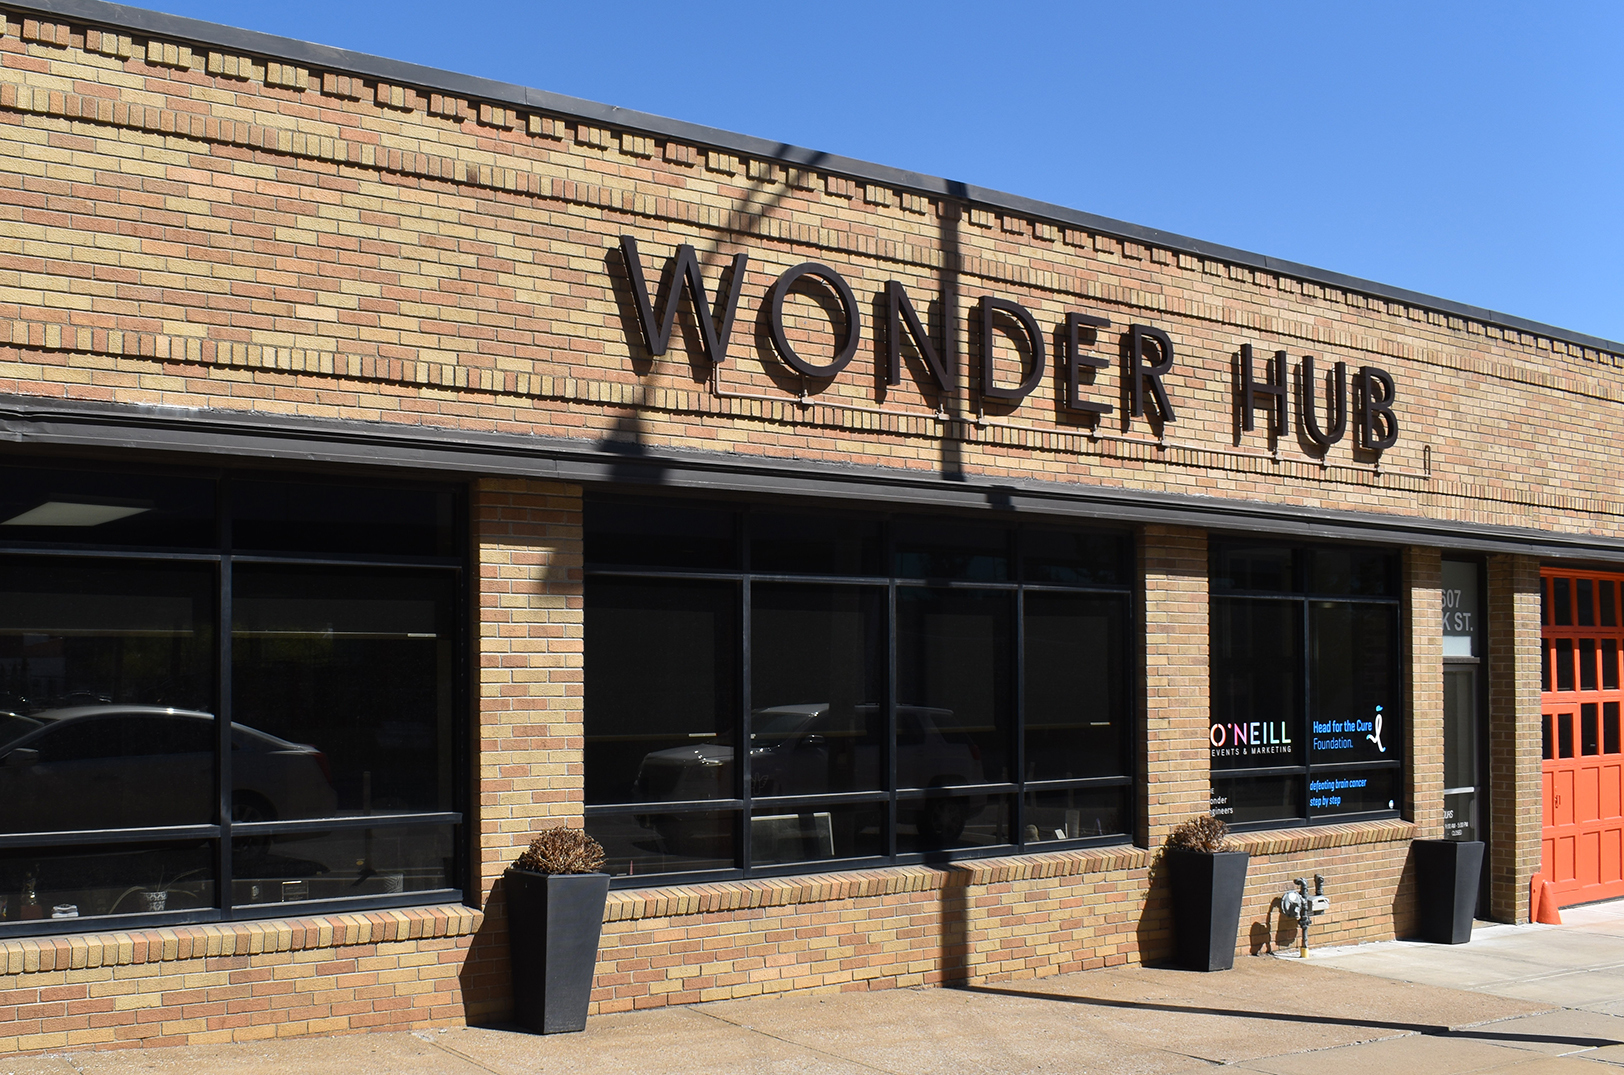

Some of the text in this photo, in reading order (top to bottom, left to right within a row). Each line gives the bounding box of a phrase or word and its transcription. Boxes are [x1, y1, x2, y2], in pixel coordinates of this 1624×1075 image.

[620, 235, 1399, 450] WONDER HUB
[1454, 612, 1473, 631] ST.
[1313, 719, 1372, 733] Head for the Cure
[1210, 721, 1292, 747] O'NEILL
[1313, 737, 1353, 750] Foundation.
[1211, 746, 1292, 757] EVENTS & MARKETING
[1309, 778, 1366, 792] defeating brain cancer
[1309, 795, 1342, 808] step by step
